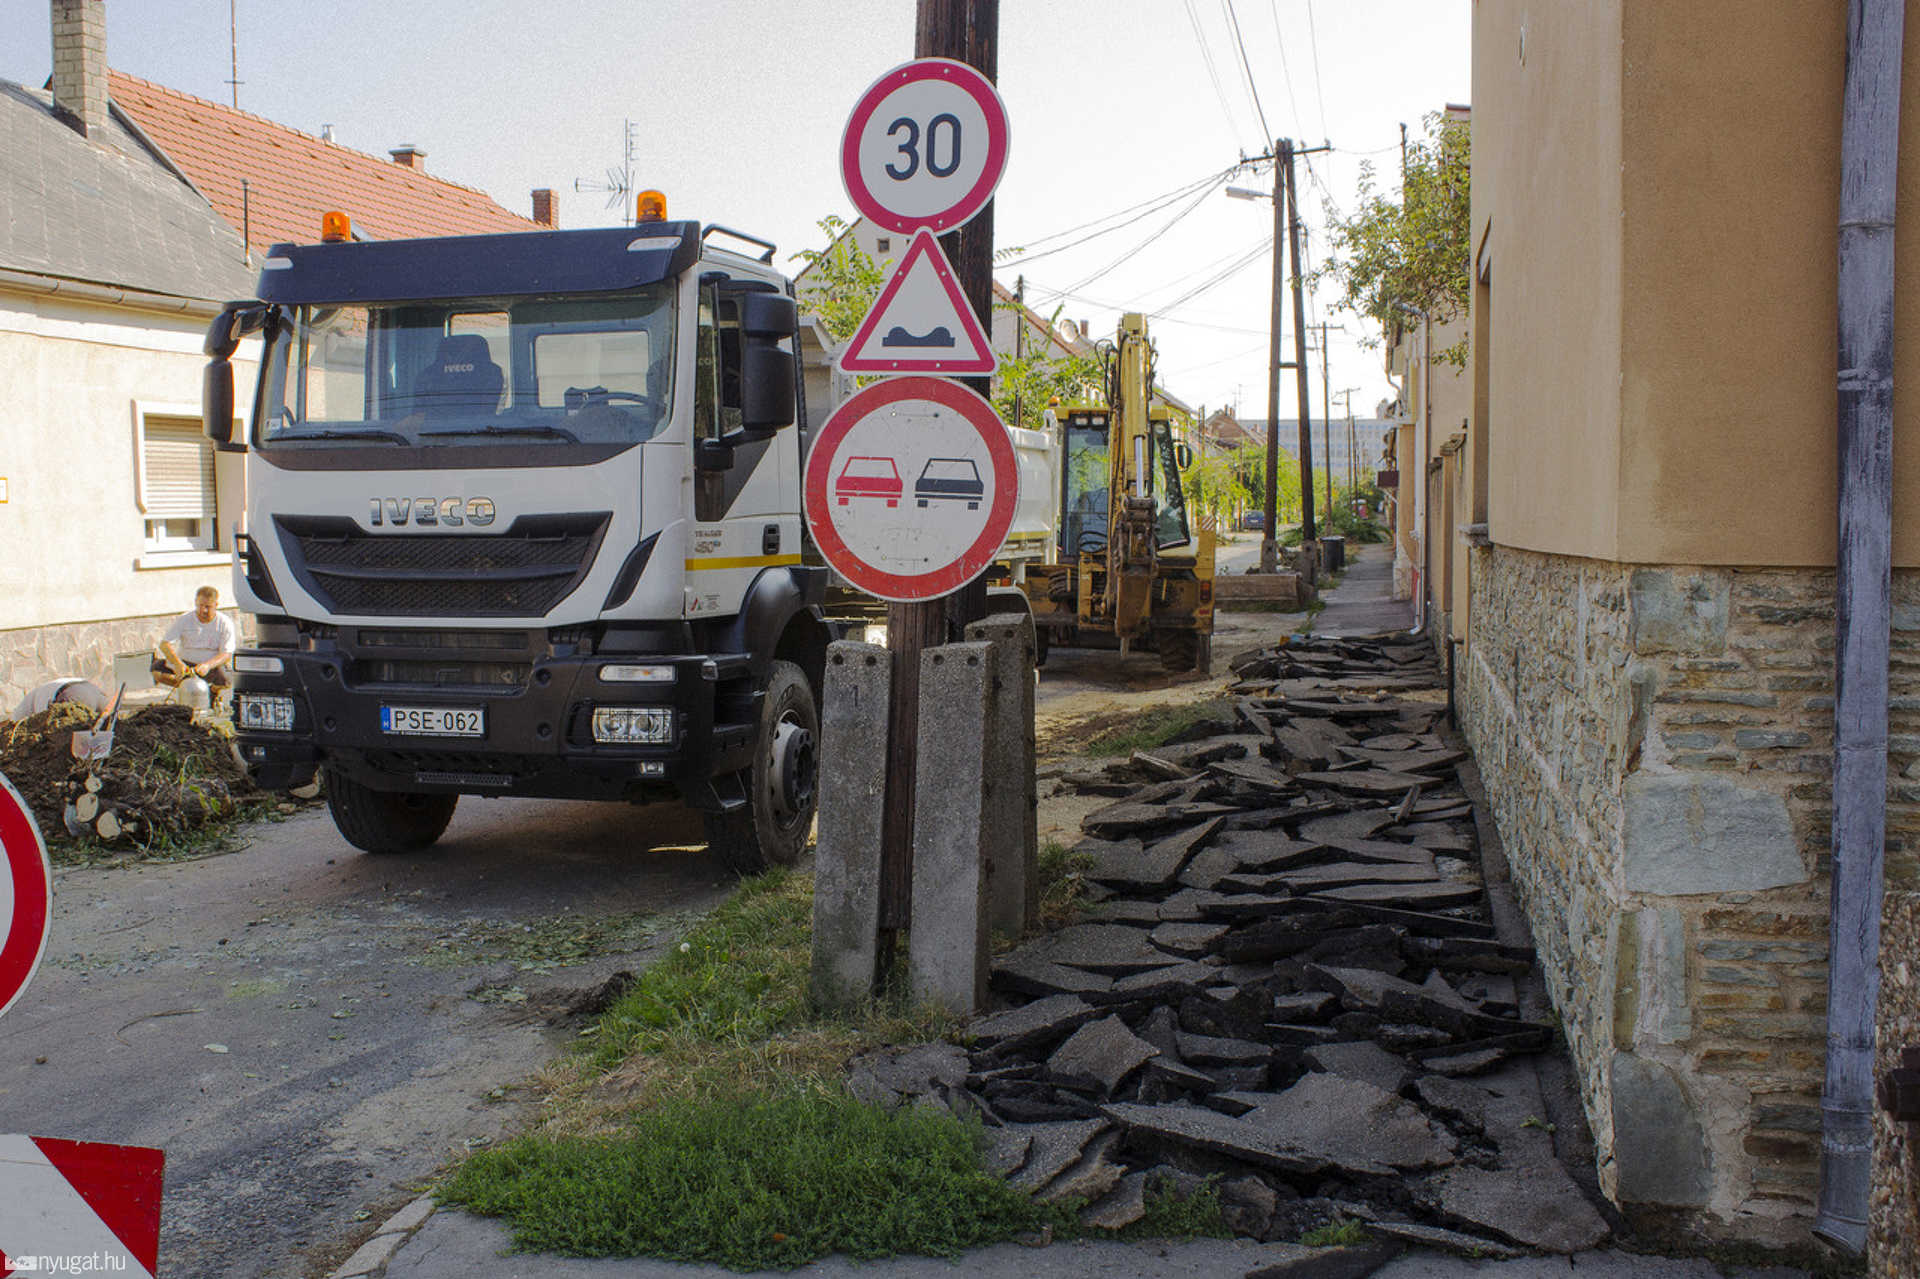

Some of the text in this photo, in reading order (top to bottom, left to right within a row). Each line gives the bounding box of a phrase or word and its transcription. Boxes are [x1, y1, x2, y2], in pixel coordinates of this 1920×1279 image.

[885, 113, 962, 181] 30
[444, 364, 474, 373] IVECO
[369, 497, 496, 527] IVECO
[394, 711, 479, 731] PSE-062
